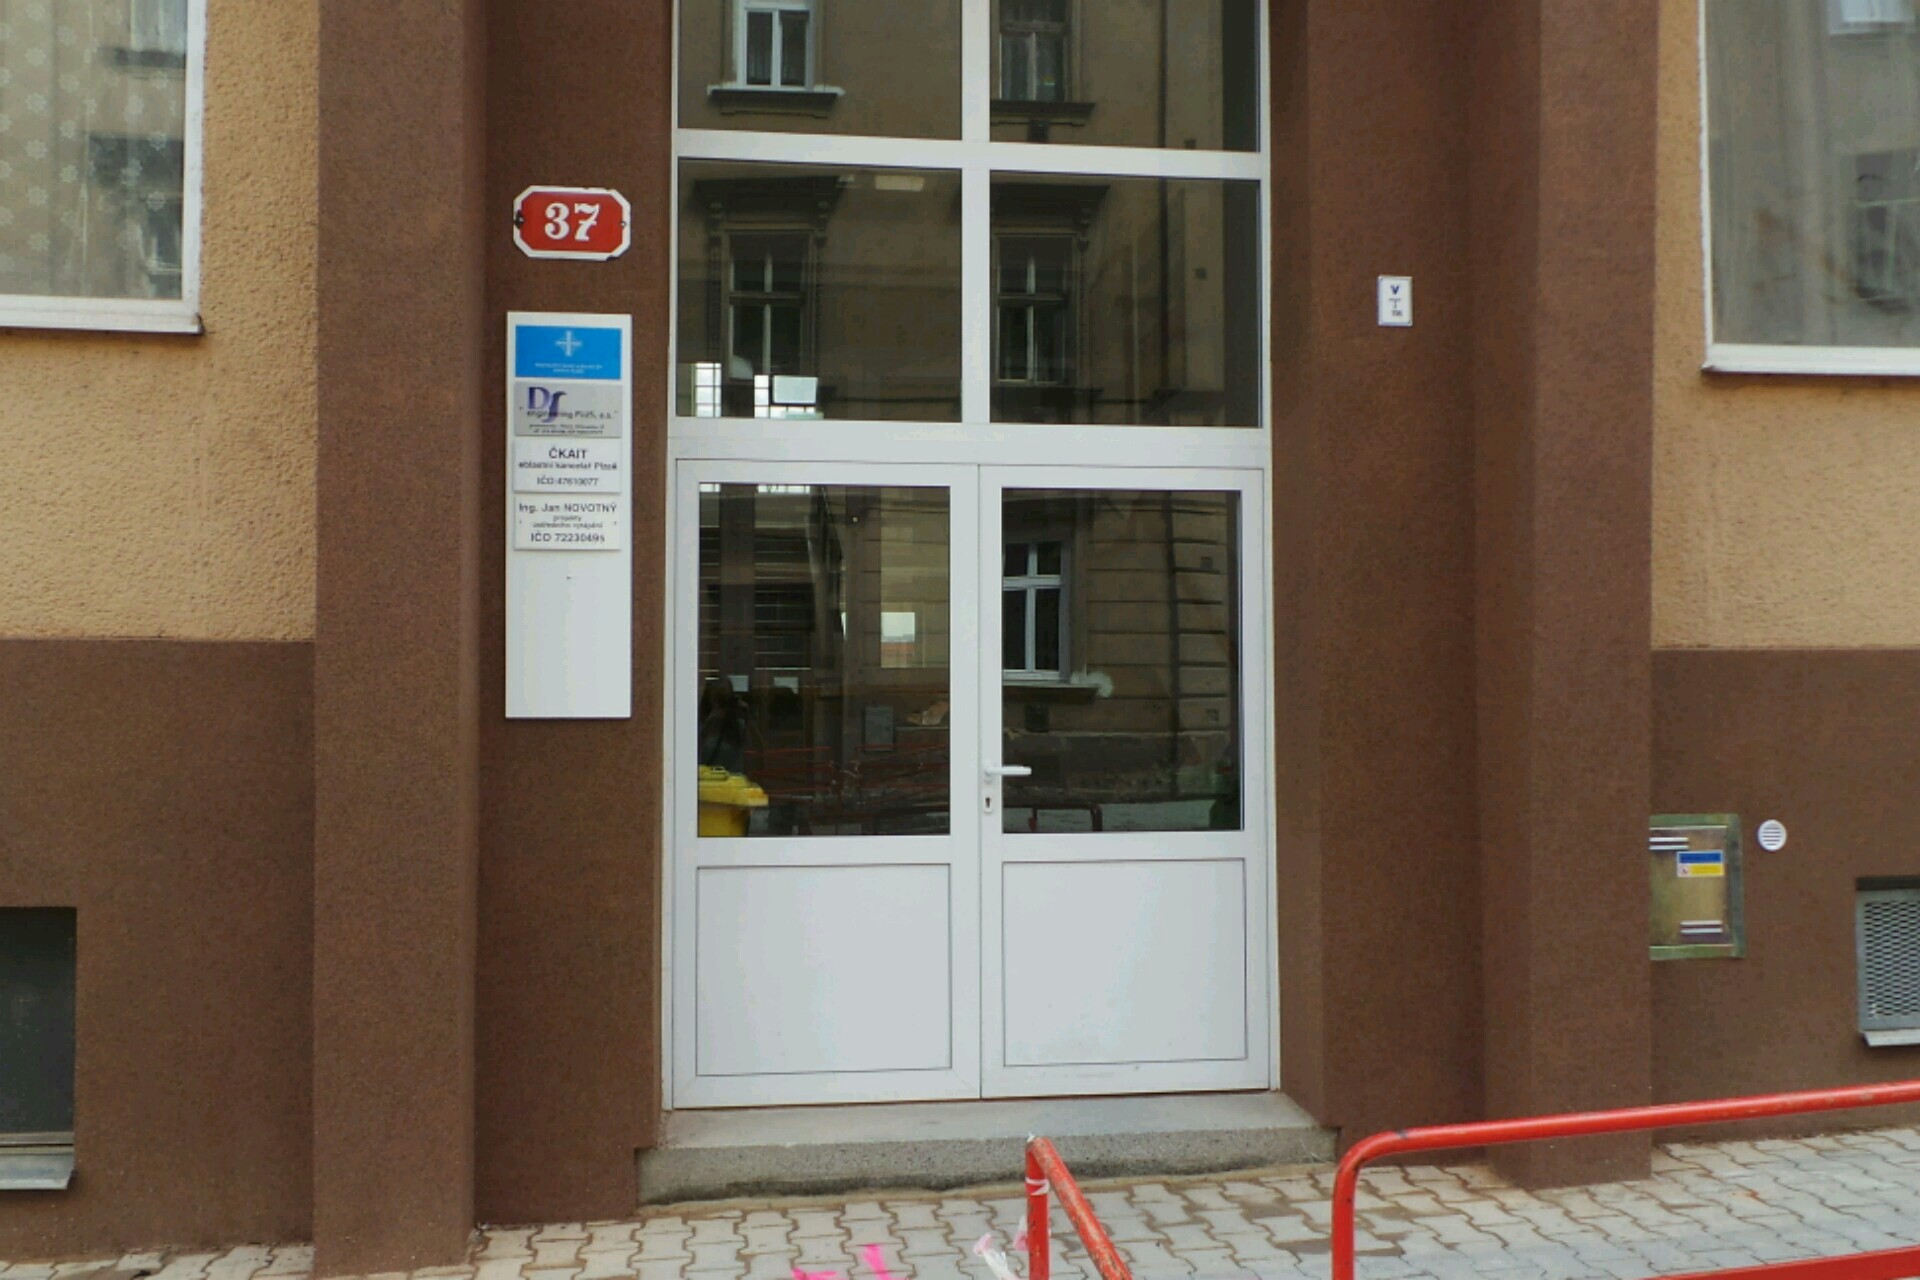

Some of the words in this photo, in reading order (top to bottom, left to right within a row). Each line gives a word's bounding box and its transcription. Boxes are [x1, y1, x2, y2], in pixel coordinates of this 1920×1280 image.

[544, 202, 600, 241] 37
[548, 446, 587, 459] ČKAIT
[519, 503, 537, 514] Ing.
[541, 503, 560, 513] Jan
[564, 501, 617, 513] NOVOTNÝ
